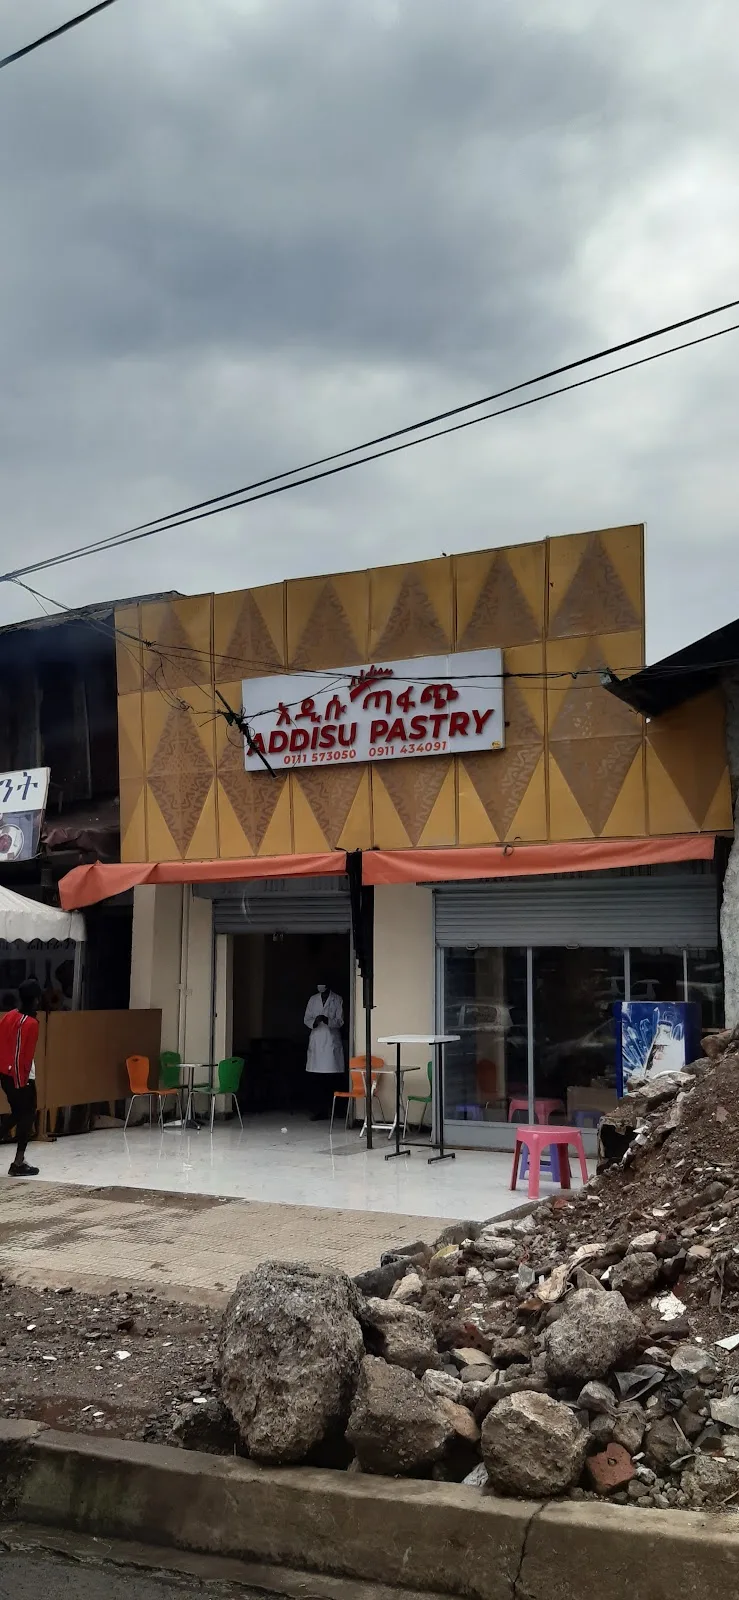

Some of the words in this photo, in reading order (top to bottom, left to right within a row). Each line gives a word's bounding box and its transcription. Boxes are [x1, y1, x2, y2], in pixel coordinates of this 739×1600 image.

[276, 694, 347, 726] አዲሱ
[362, 683, 460, 715] ጣፋጭ
[246, 722, 358, 757] ADDISU
[369, 709, 495, 744] PASTRY
[283, 754, 308, 765] 0111
[311, 749, 357, 763] 573050
[368, 746, 395, 758] 0911
[399, 741, 447, 755] 434091
